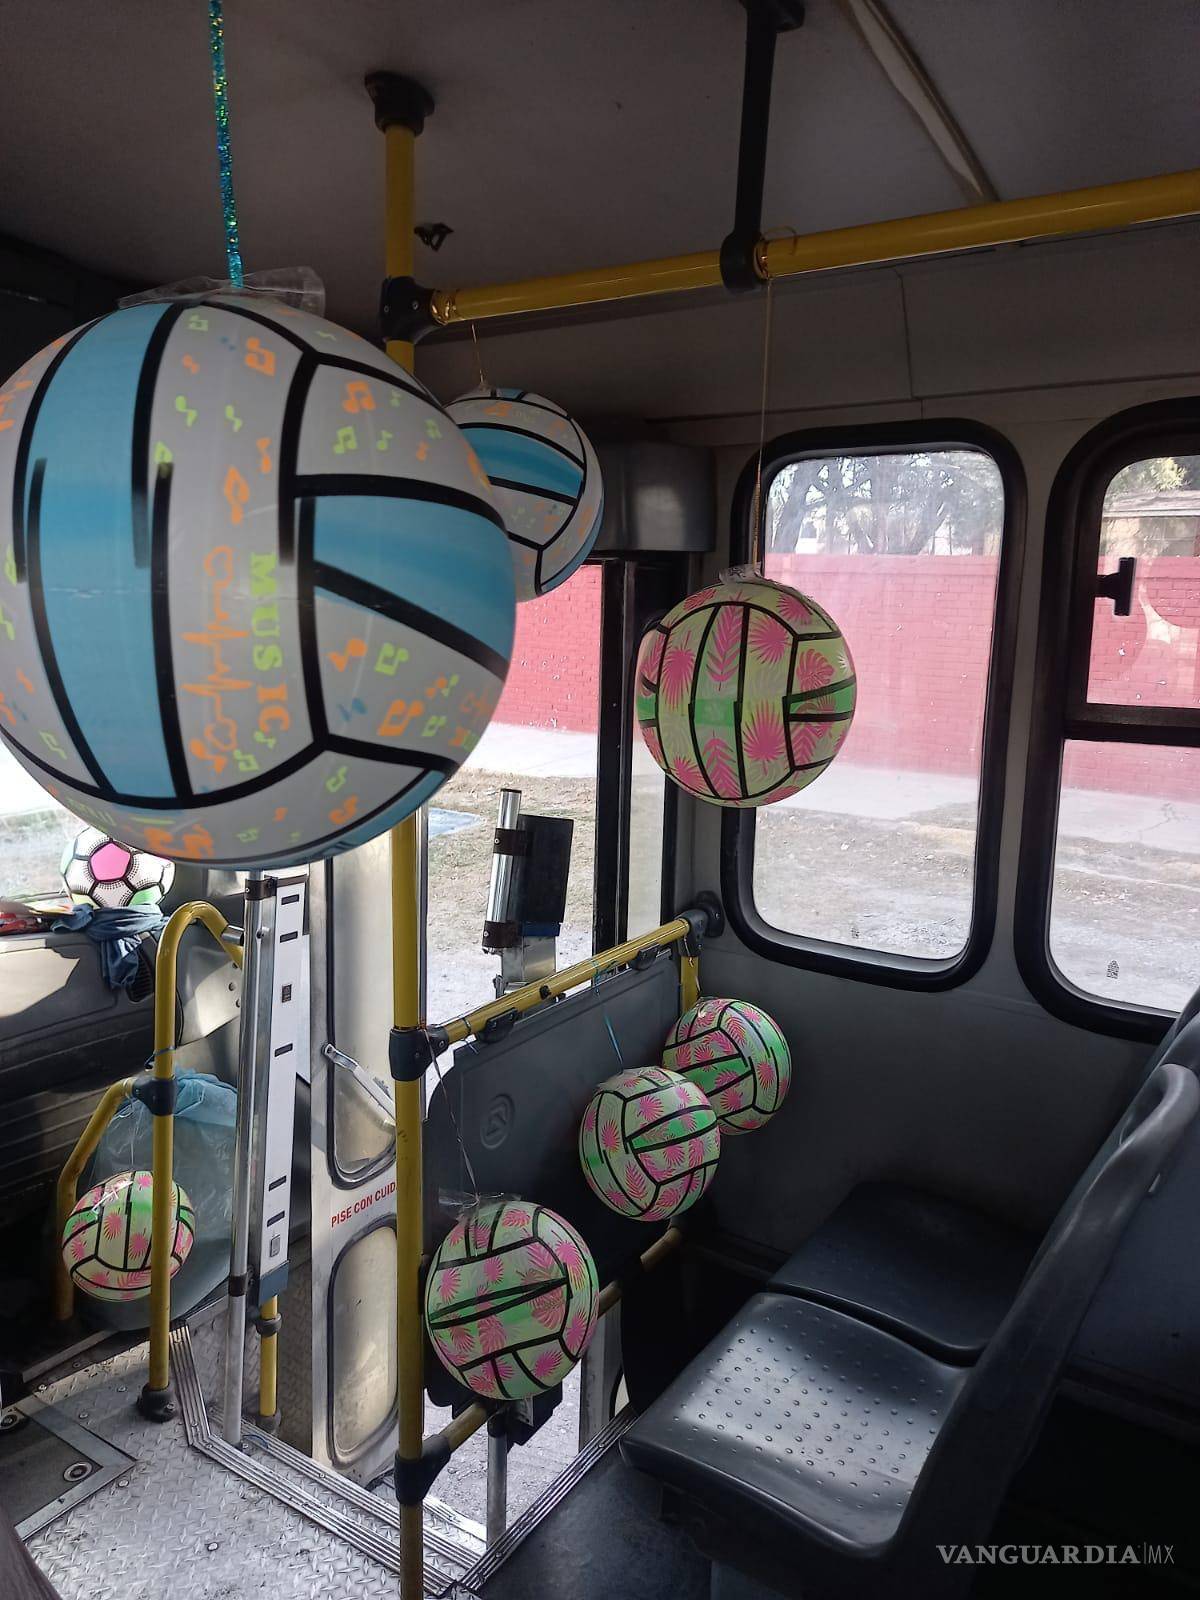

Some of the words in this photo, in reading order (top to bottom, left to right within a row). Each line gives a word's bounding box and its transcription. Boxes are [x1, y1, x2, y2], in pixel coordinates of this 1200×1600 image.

[249, 552, 291, 732] MUSIC
[331, 1206, 352, 1228] PISE
[354, 1195, 373, 1214] CON
[374, 1182, 397, 1202] CUID
